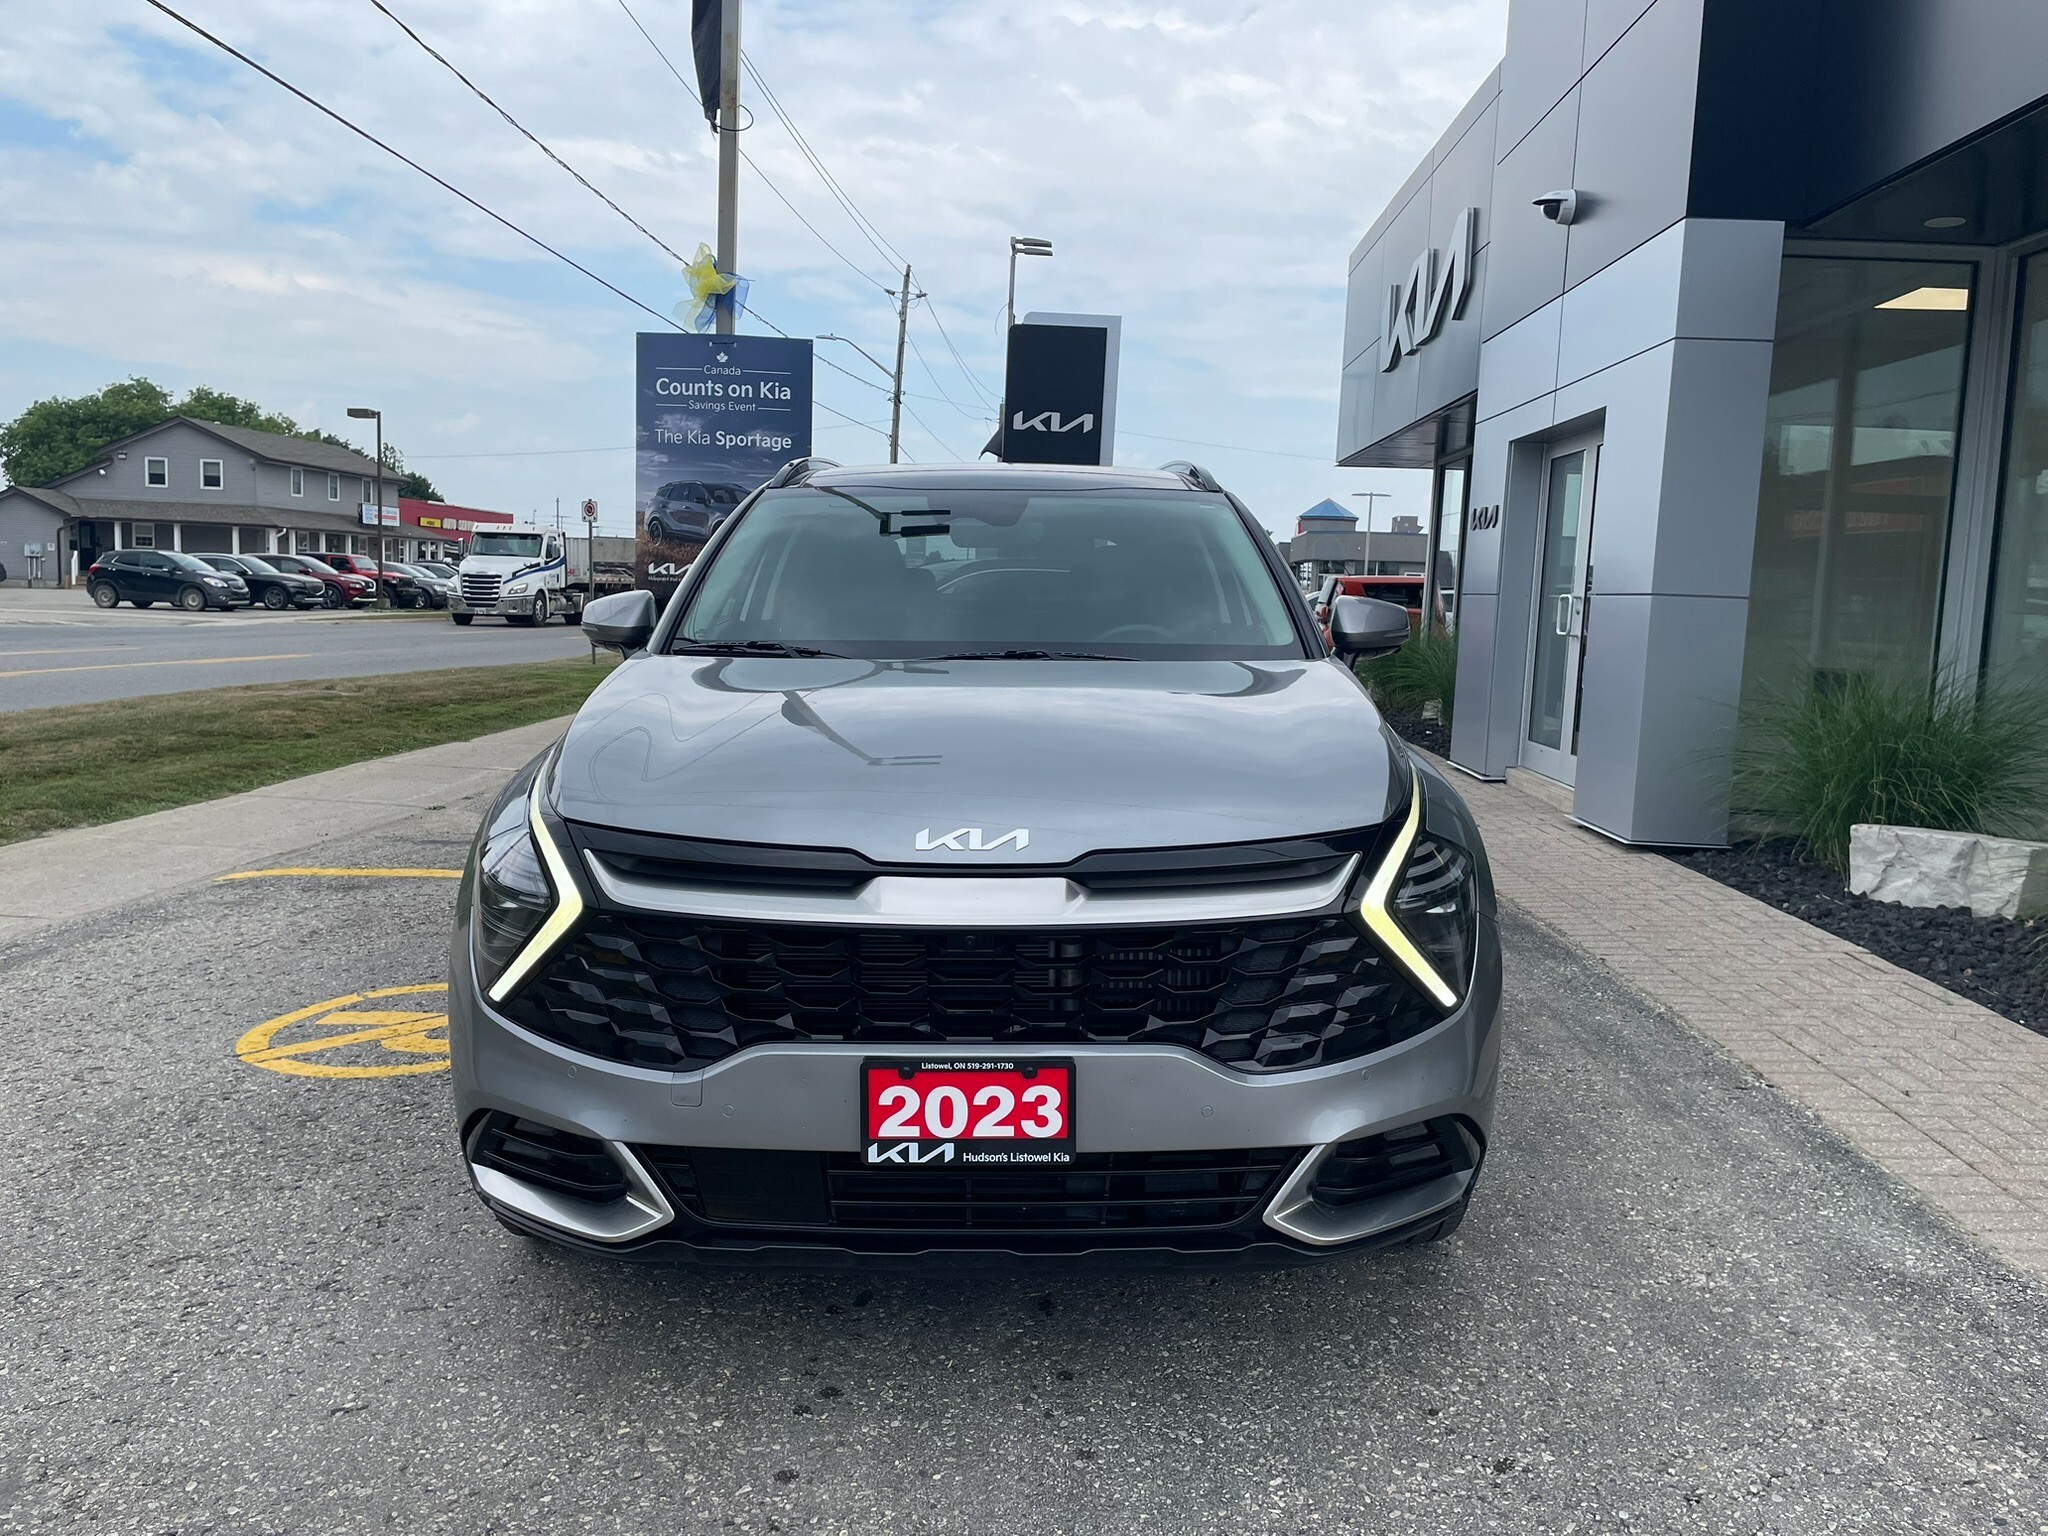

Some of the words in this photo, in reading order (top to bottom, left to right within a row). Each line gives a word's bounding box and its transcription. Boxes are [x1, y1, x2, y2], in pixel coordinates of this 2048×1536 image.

[1381, 206, 1479, 373] KIA
[703, 364, 741, 376] Canada
[656, 377, 724, 397] Counts
[728, 384, 753, 398] on
[760, 381, 791, 400] Kia
[688, 400, 726, 412] Savings
[728, 401, 756, 412] Event
[1013, 410, 1093, 433] KIA
[655, 428, 683, 445] The
[687, 430, 711, 445] Kia
[715, 430, 792, 452] Sportage
[1470, 504, 1500, 531] KIA
[915, 827, 1030, 851] KIA
[921, 1062, 953, 1070] Listowel,
[953, 1062, 966, 1070] ON
[967, 1062, 1014, 1070] 519-291-1730
[878, 1085, 1063, 1138] 2023
[868, 1142, 955, 1163] KIA
[963, 1152, 1008, 1163] Hudson's
[1010, 1152, 1051, 1163] Listowel
[1053, 1152, 1070, 1163] Kia
